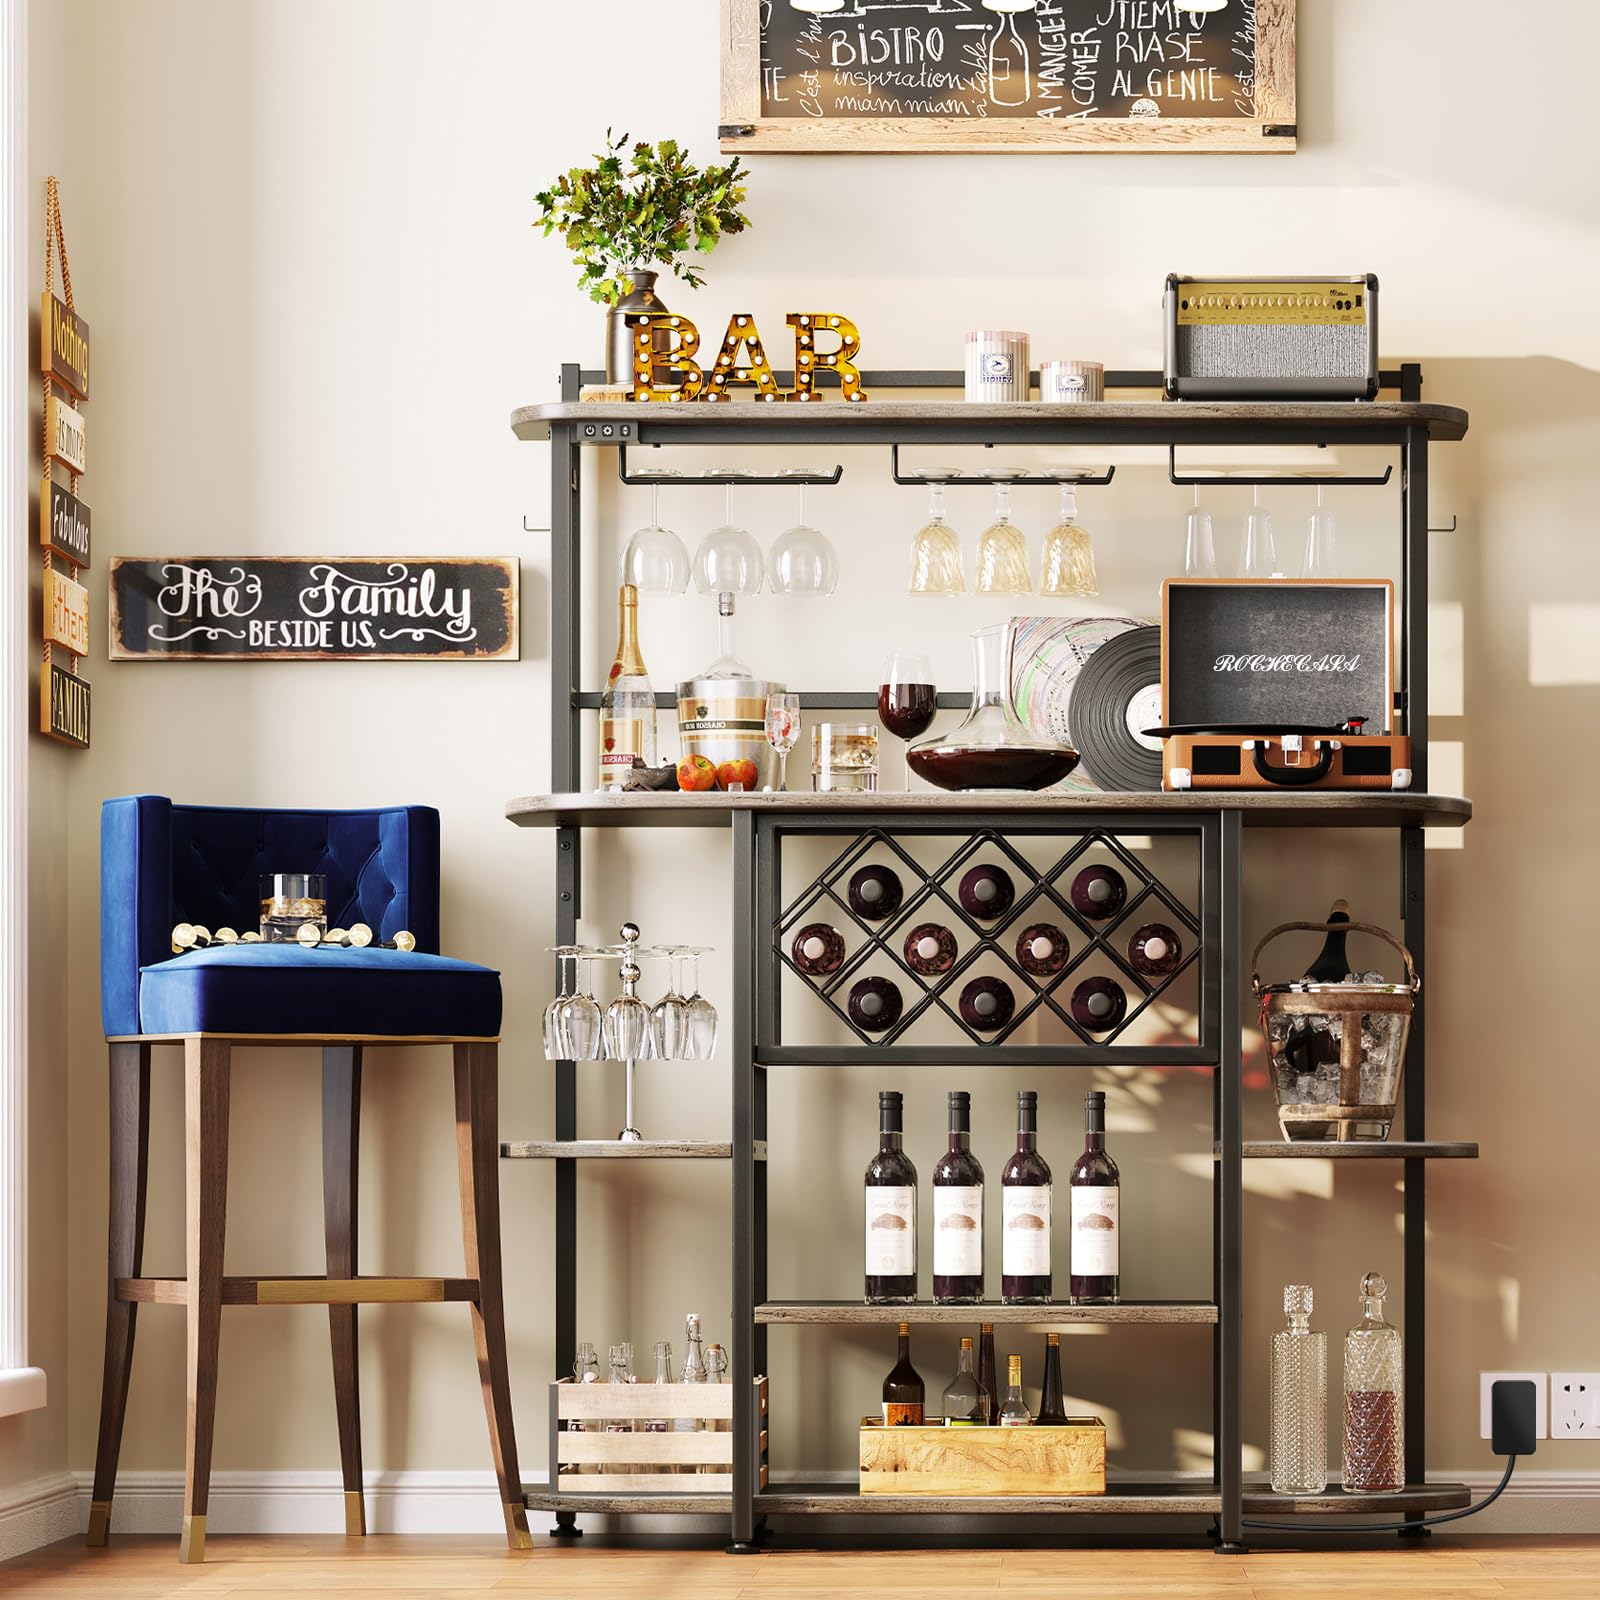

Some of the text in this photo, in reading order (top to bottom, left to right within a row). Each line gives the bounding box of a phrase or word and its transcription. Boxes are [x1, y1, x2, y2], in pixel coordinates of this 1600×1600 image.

[1034, 0, 1068, 99] MANGER
[1070, 27, 1102, 105] COMER
[1116, 31, 1206, 63] RIASE
[1147, 66, 1224, 102] GENTE
[53, 300, 88, 393] Nothing
[624, 312, 868, 402] BAR
[53, 494, 89, 555] Fabulous
[299, 563, 471, 632] Family
[249, 620, 333, 647] BESIDE
[52, 671, 90, 743] FAMILY
